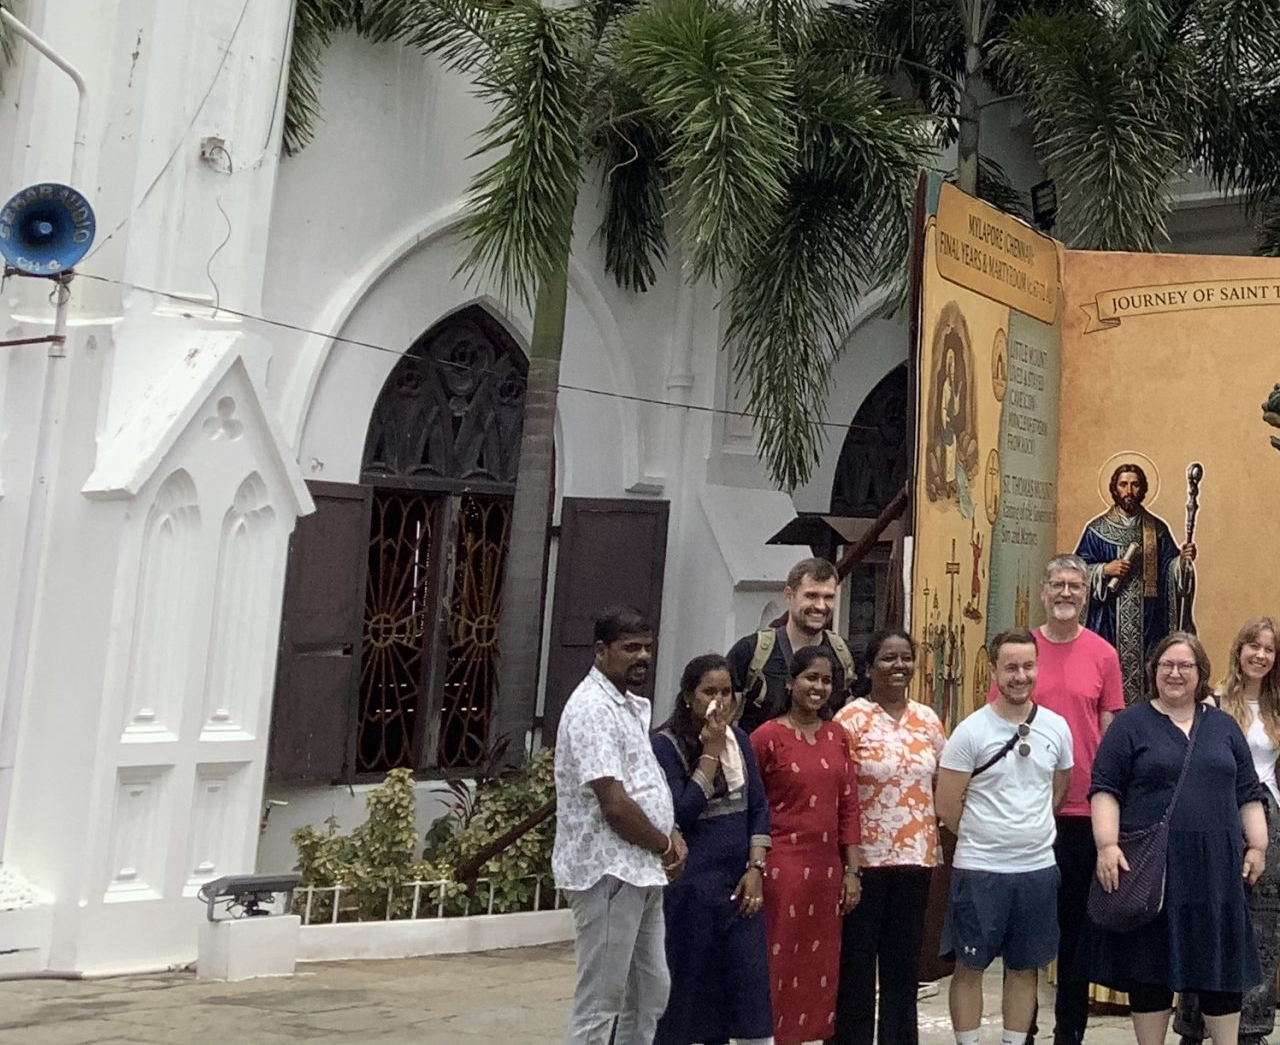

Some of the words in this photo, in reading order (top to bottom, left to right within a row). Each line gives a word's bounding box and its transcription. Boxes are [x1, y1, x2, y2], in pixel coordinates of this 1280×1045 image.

[968, 214, 1003, 251] MYLAPORE
[939, 231, 960, 261] FINAL
[961, 241, 982, 272] YEARS
[1111, 290, 1188, 314] JOURNEY
[1193, 288, 1214, 303] OF
[1220, 286, 1269, 301] SAINT
